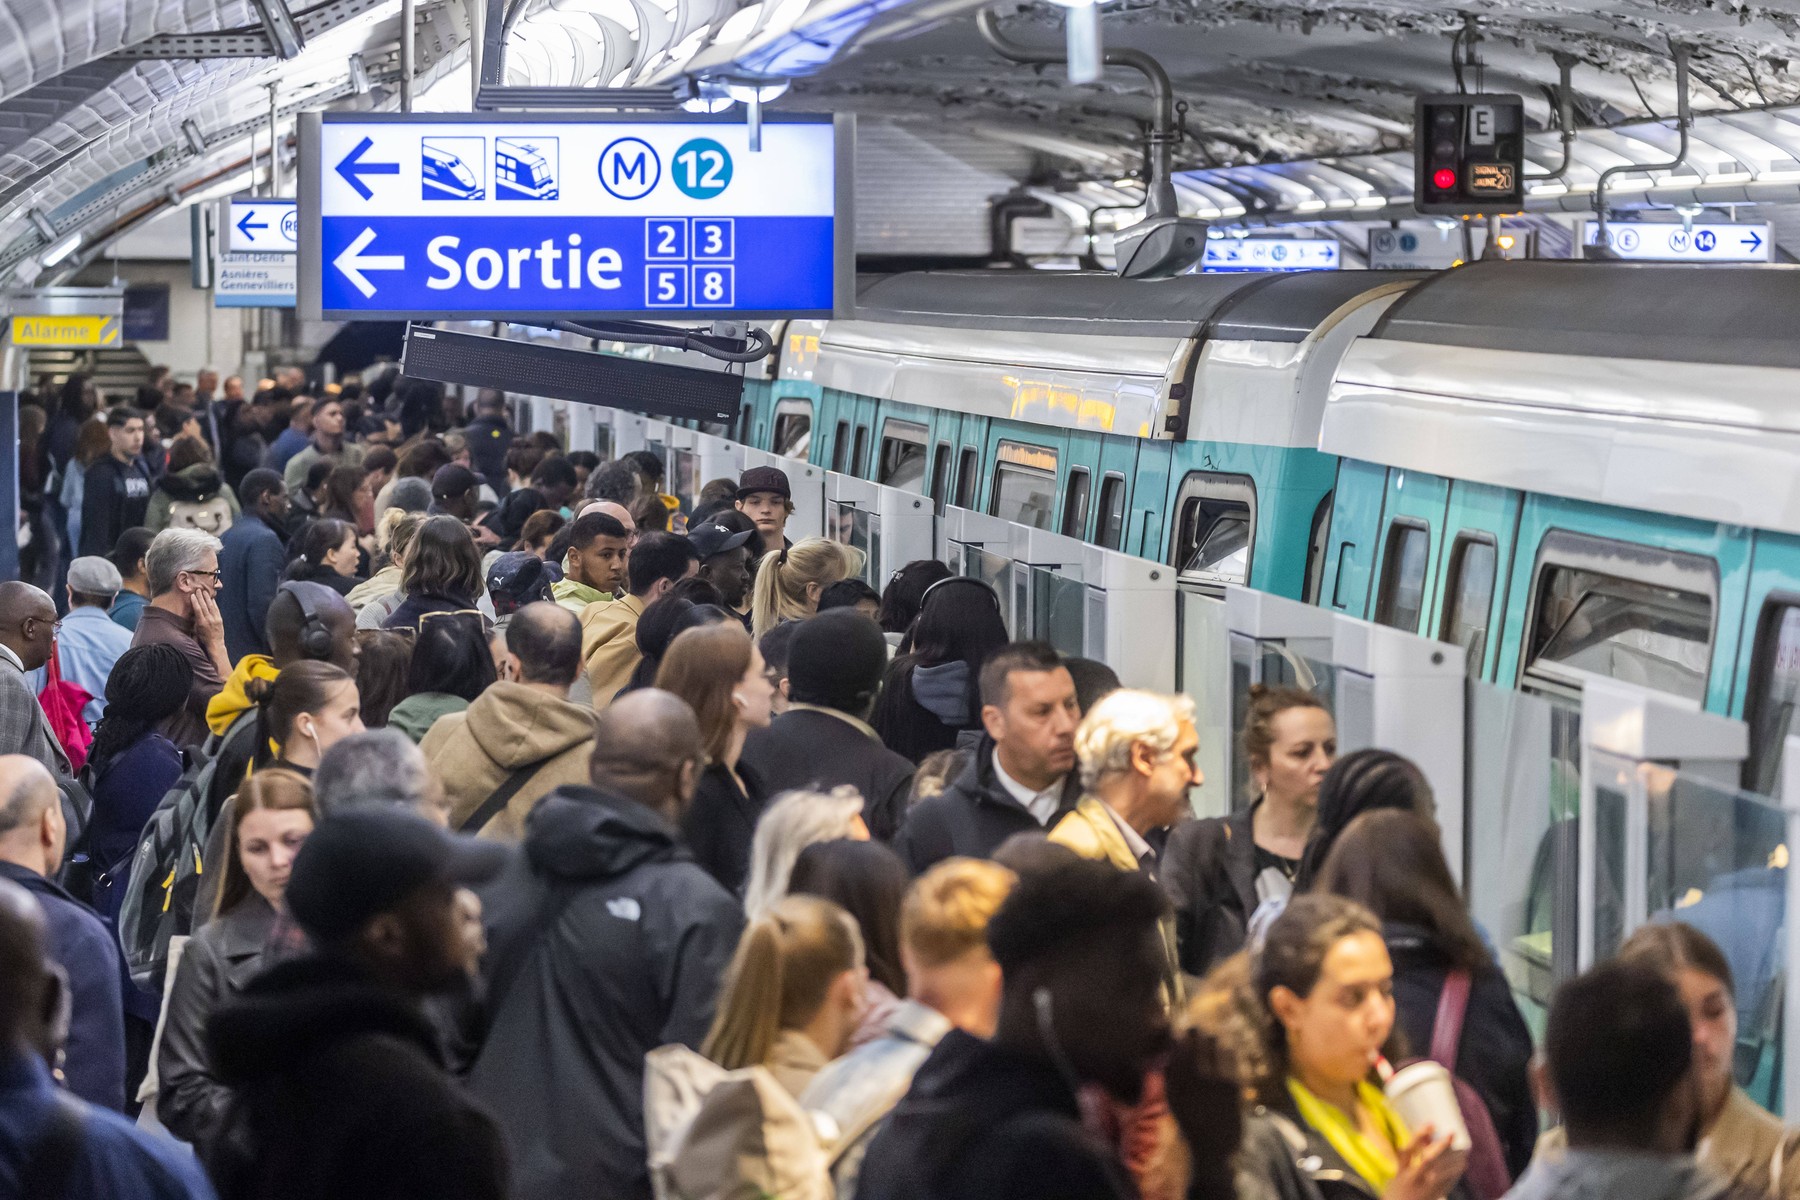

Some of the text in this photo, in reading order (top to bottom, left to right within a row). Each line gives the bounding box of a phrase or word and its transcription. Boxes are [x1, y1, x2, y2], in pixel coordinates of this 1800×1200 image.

[1476, 110, 1489, 135] E
[614, 150, 725, 188] M 12
[285, 220, 297, 232] RE
[657, 225, 723, 254] 2 3
[1674, 234, 1714, 249] M 14
[426, 233, 623, 290] Sortie
[221, 269, 269, 279] Asnières
[221, 280, 294, 290] Gennevilliers
[657, 271, 724, 301] 5 8
[22, 321, 90, 338] Alarme
